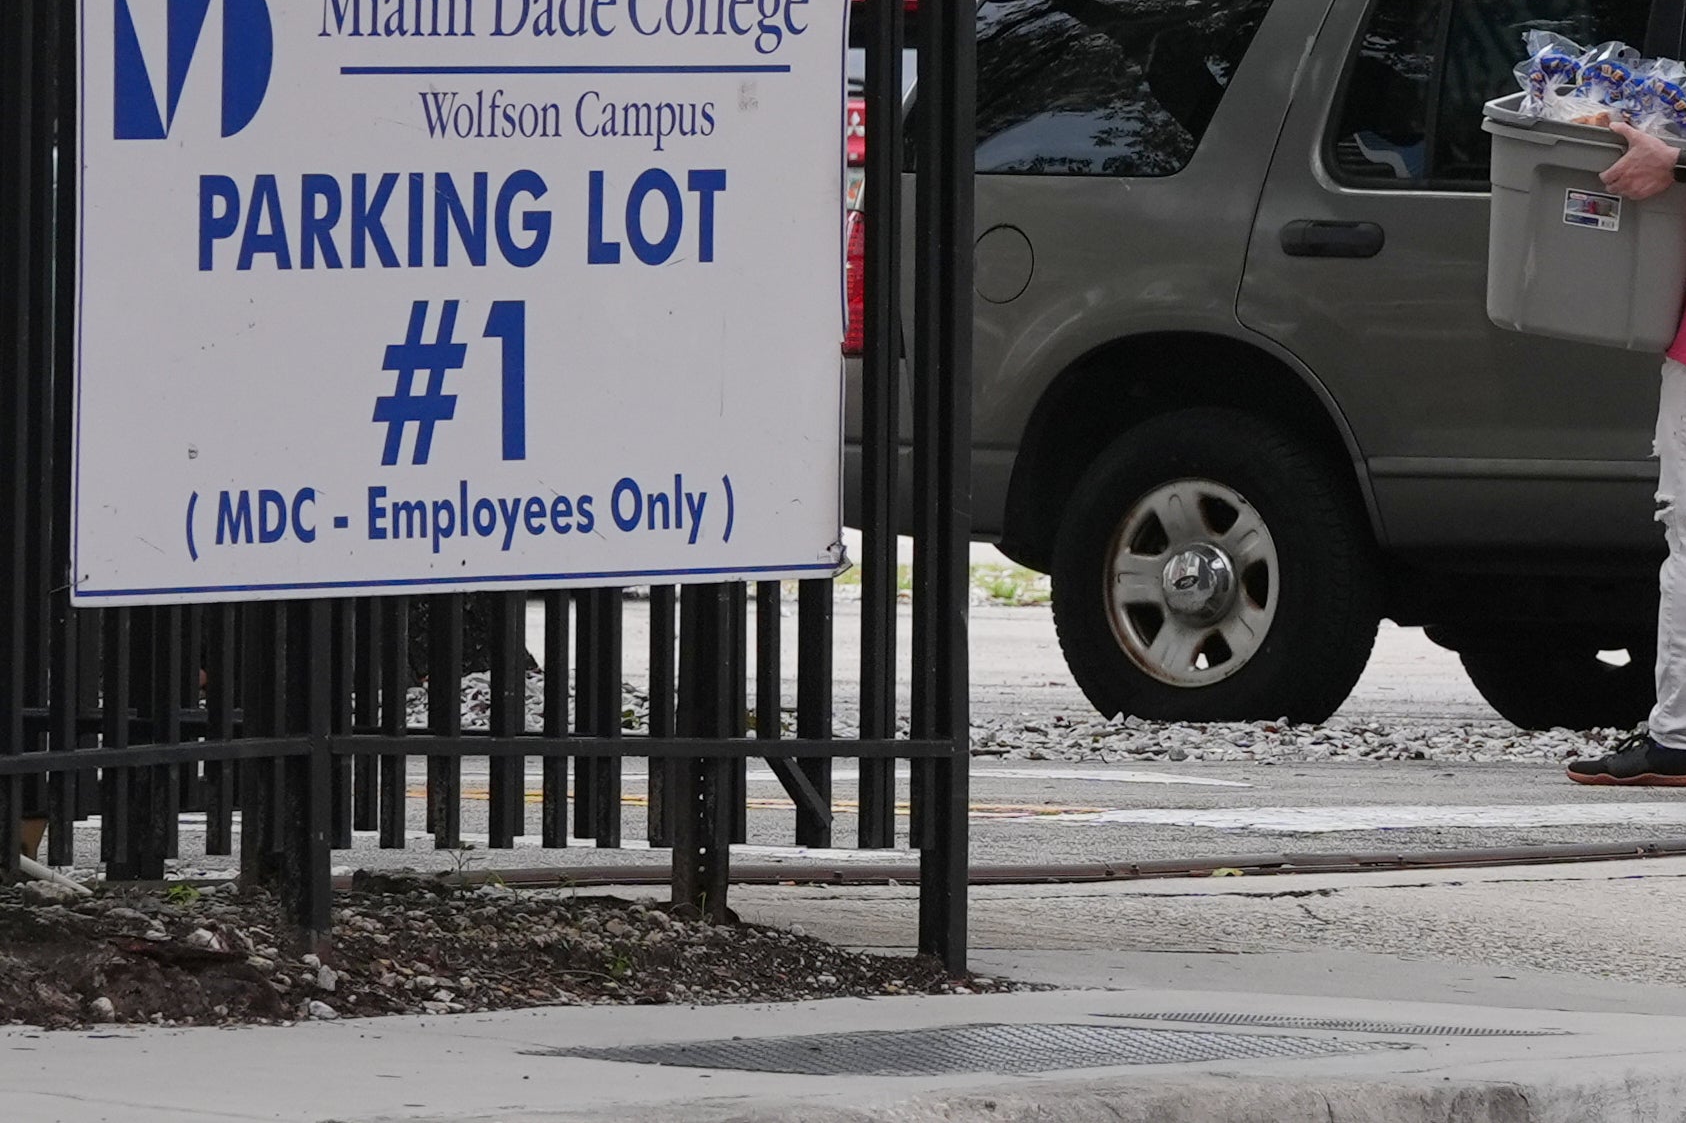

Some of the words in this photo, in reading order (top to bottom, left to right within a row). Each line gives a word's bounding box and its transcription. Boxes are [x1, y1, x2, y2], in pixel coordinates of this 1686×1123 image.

[420, 90, 559, 138] Wolfson
[576, 91, 714, 151] Campus
[199, 170, 551, 271] PARKING
[588, 168, 726, 265] LOT
[373, 300, 525, 465] #1
[368, 481, 594, 553] Employees
